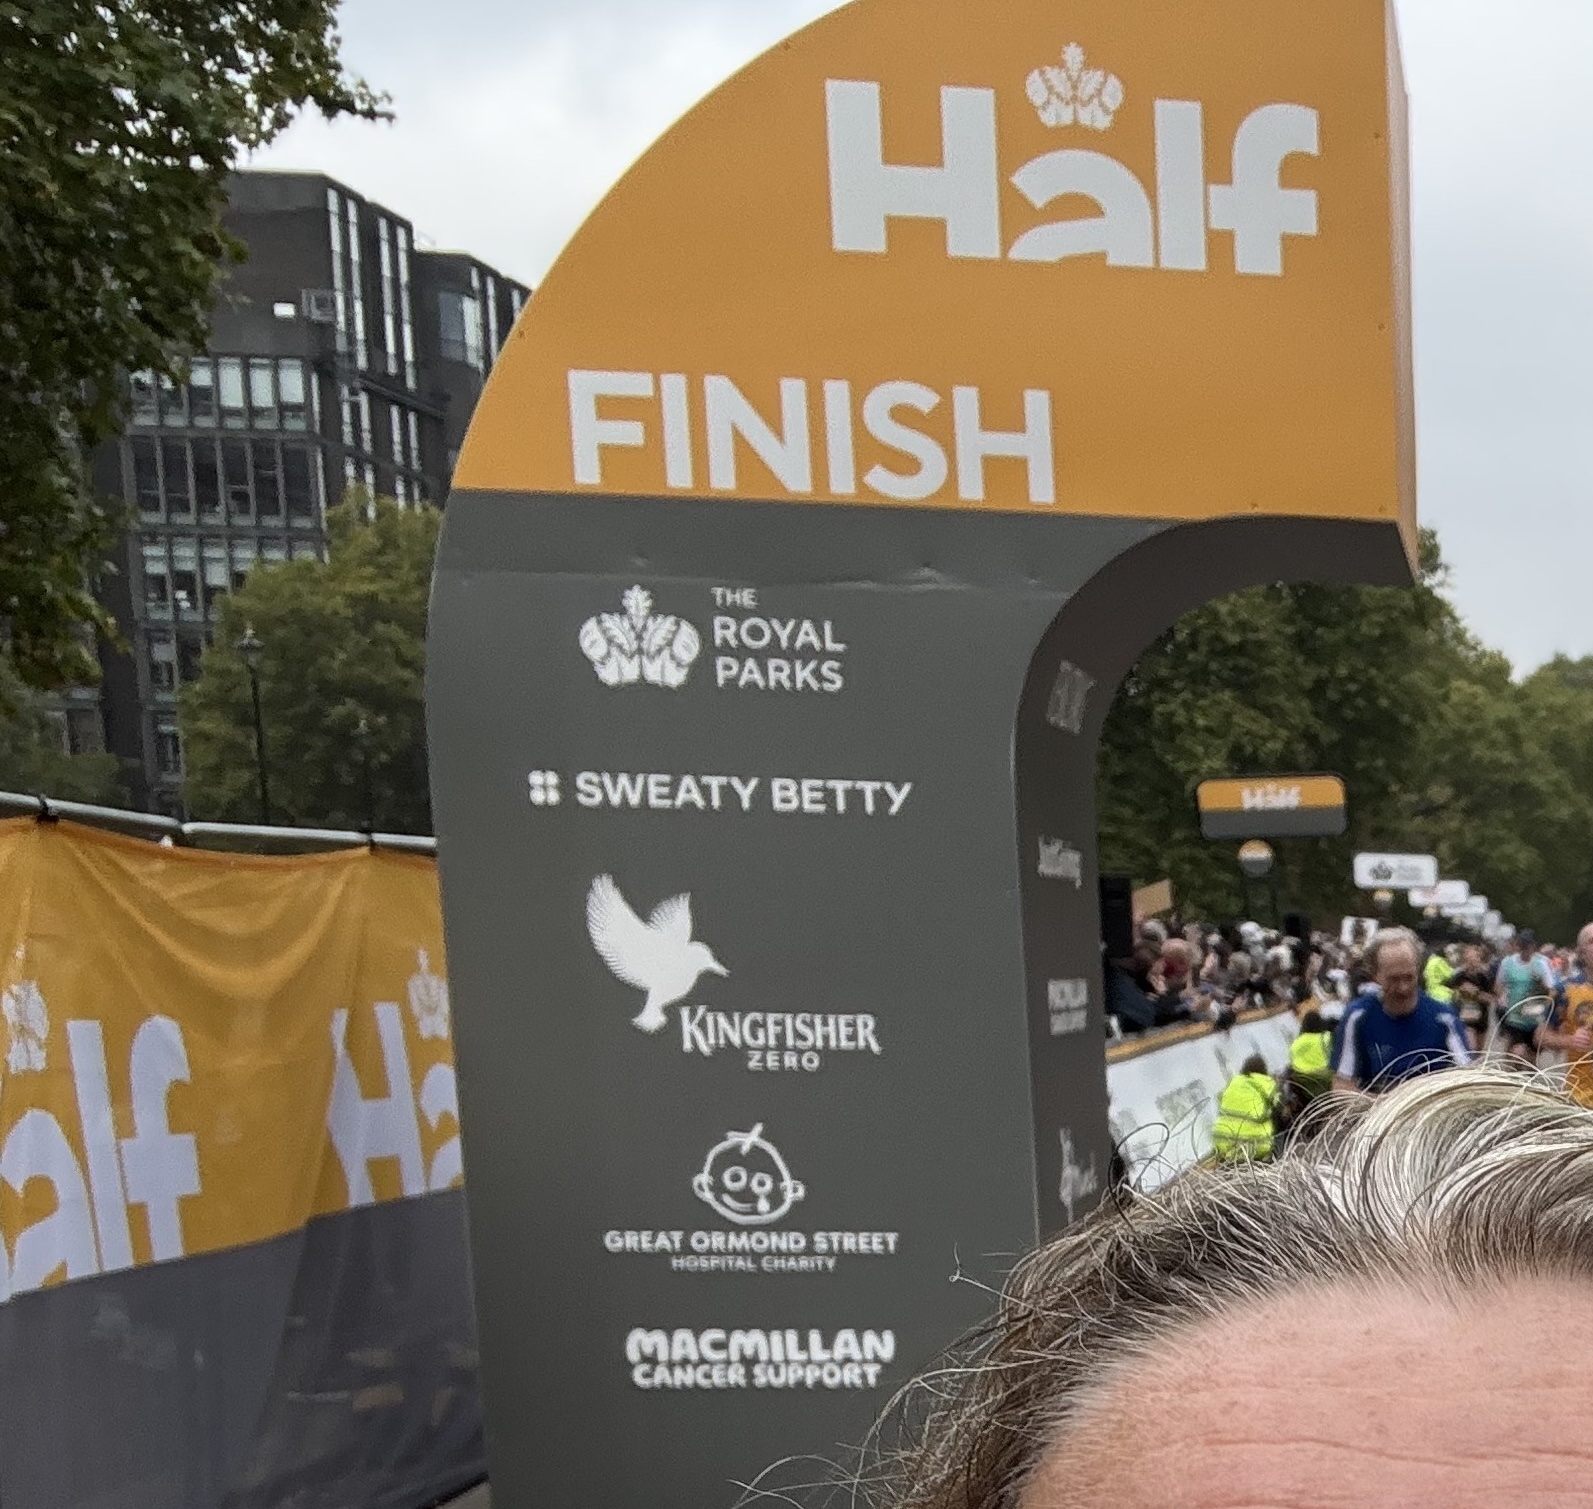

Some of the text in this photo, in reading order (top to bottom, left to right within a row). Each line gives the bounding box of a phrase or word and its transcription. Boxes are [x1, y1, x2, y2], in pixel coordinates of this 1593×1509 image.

[824, 78, 1320, 276] Half
[567, 368, 1056, 504] FINISH
[711, 587, 758, 608] THE
[712, 616, 847, 653] ROYAL
[715, 656, 844, 692] PARKS
[575, 771, 912, 816] SWEATY BETTY
[679, 1004, 882, 1056] KINGFISHER
[747, 1050, 820, 1072] ZERO
[0, 1014, 200, 1302] alf
[603, 1230, 899, 1255] GREAT ORMOND STREET
[671, 1255, 837, 1273] HOSPITAL CHARITY
[625, 1327, 895, 1363] MACMILLAN
[631, 1362, 882, 1389] CANCER SUPPORT
